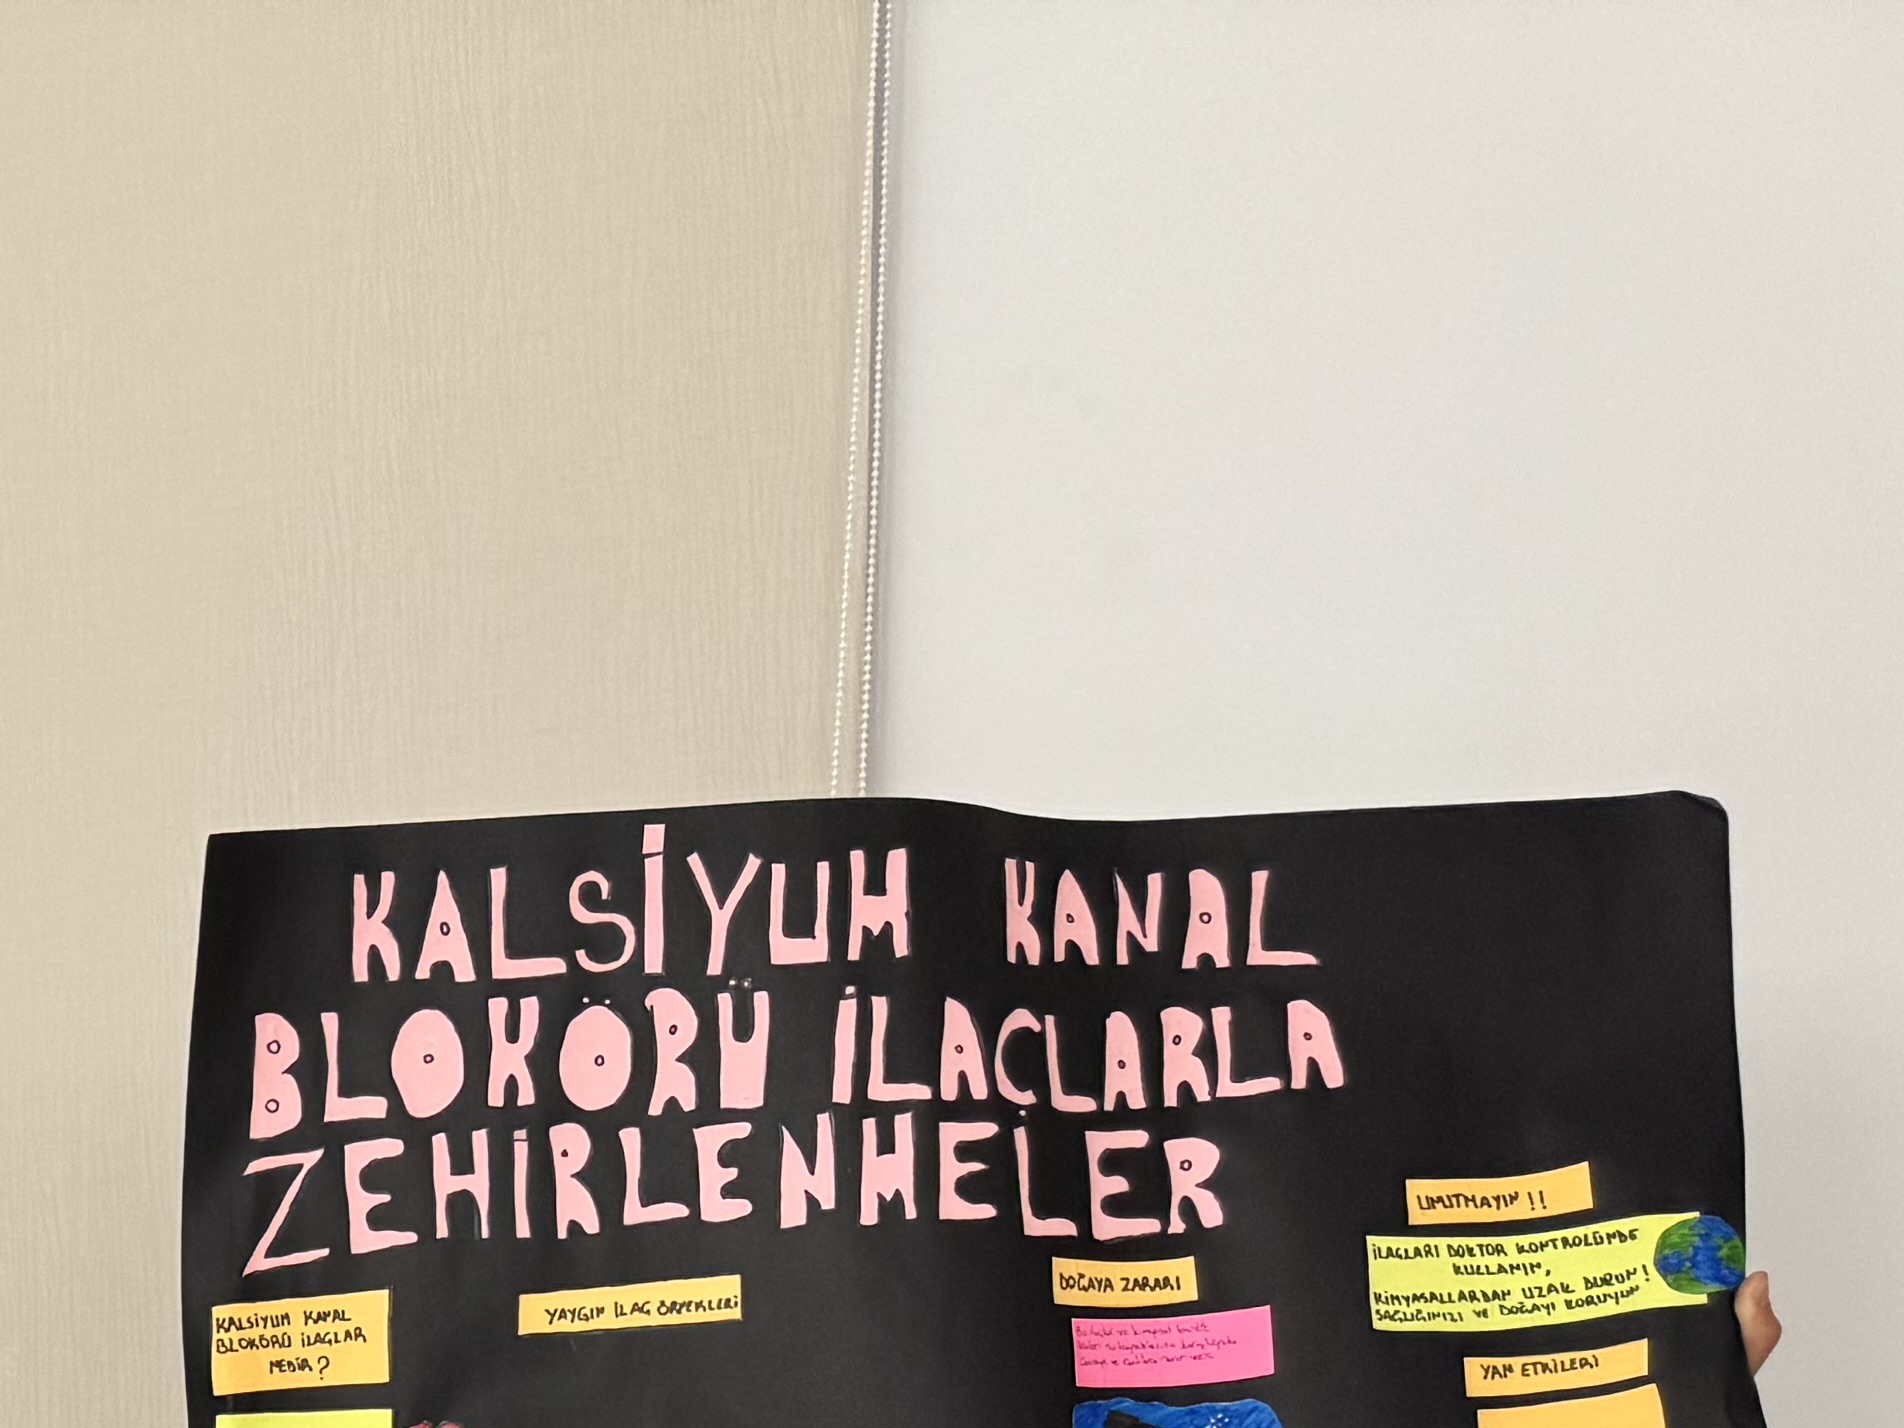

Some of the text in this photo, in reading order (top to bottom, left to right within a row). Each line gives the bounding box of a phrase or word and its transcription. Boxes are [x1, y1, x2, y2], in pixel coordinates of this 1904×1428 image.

[351, 823, 1324, 982] KALSİYUM KANAL
[248, 975, 771, 1140] BLOKÖRÜ
[241, 1112, 1225, 1278] ZEHİRLENMELER
[1448, 1243, 1508, 1258] DOKTOR
[1060, 1272, 1180, 1293] DOĞAYA ZARARI
[1373, 1289, 1512, 1307] KİMYASALLARDAN
[1522, 1282, 1575, 1299] UZAK
[1500, 1302, 1555, 1316] DOĞAYI
[1565, 1285, 1640, 1310] KORUYUN
[216, 1309, 352, 1334] KALSİYUM KANAL
[545, 1307, 605, 1325] YAYGIN
[216, 1332, 291, 1354] BLOKÖRÜ
[1480, 1364, 1514, 1380] YAN
